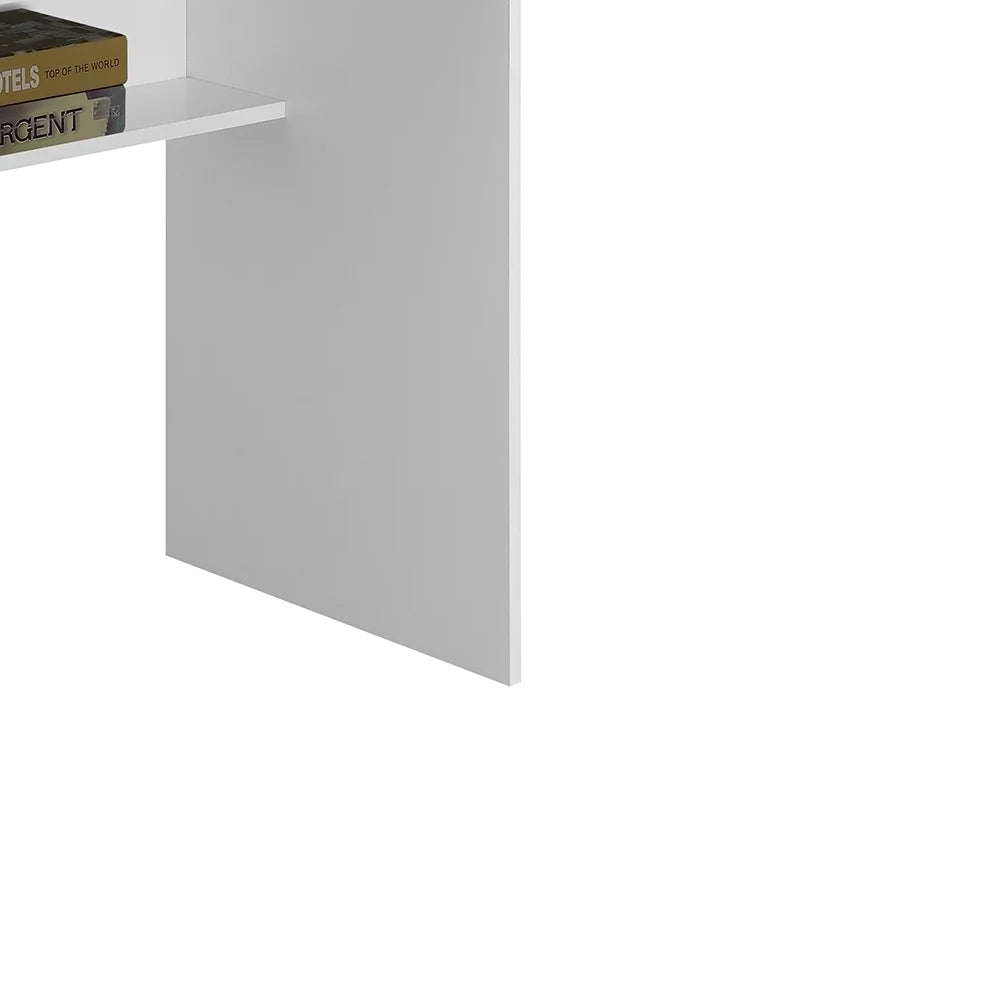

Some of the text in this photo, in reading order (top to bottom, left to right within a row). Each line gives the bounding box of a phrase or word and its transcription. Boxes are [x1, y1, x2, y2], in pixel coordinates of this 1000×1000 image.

[45, 58, 120, 80] TOP OF THE WORLD
